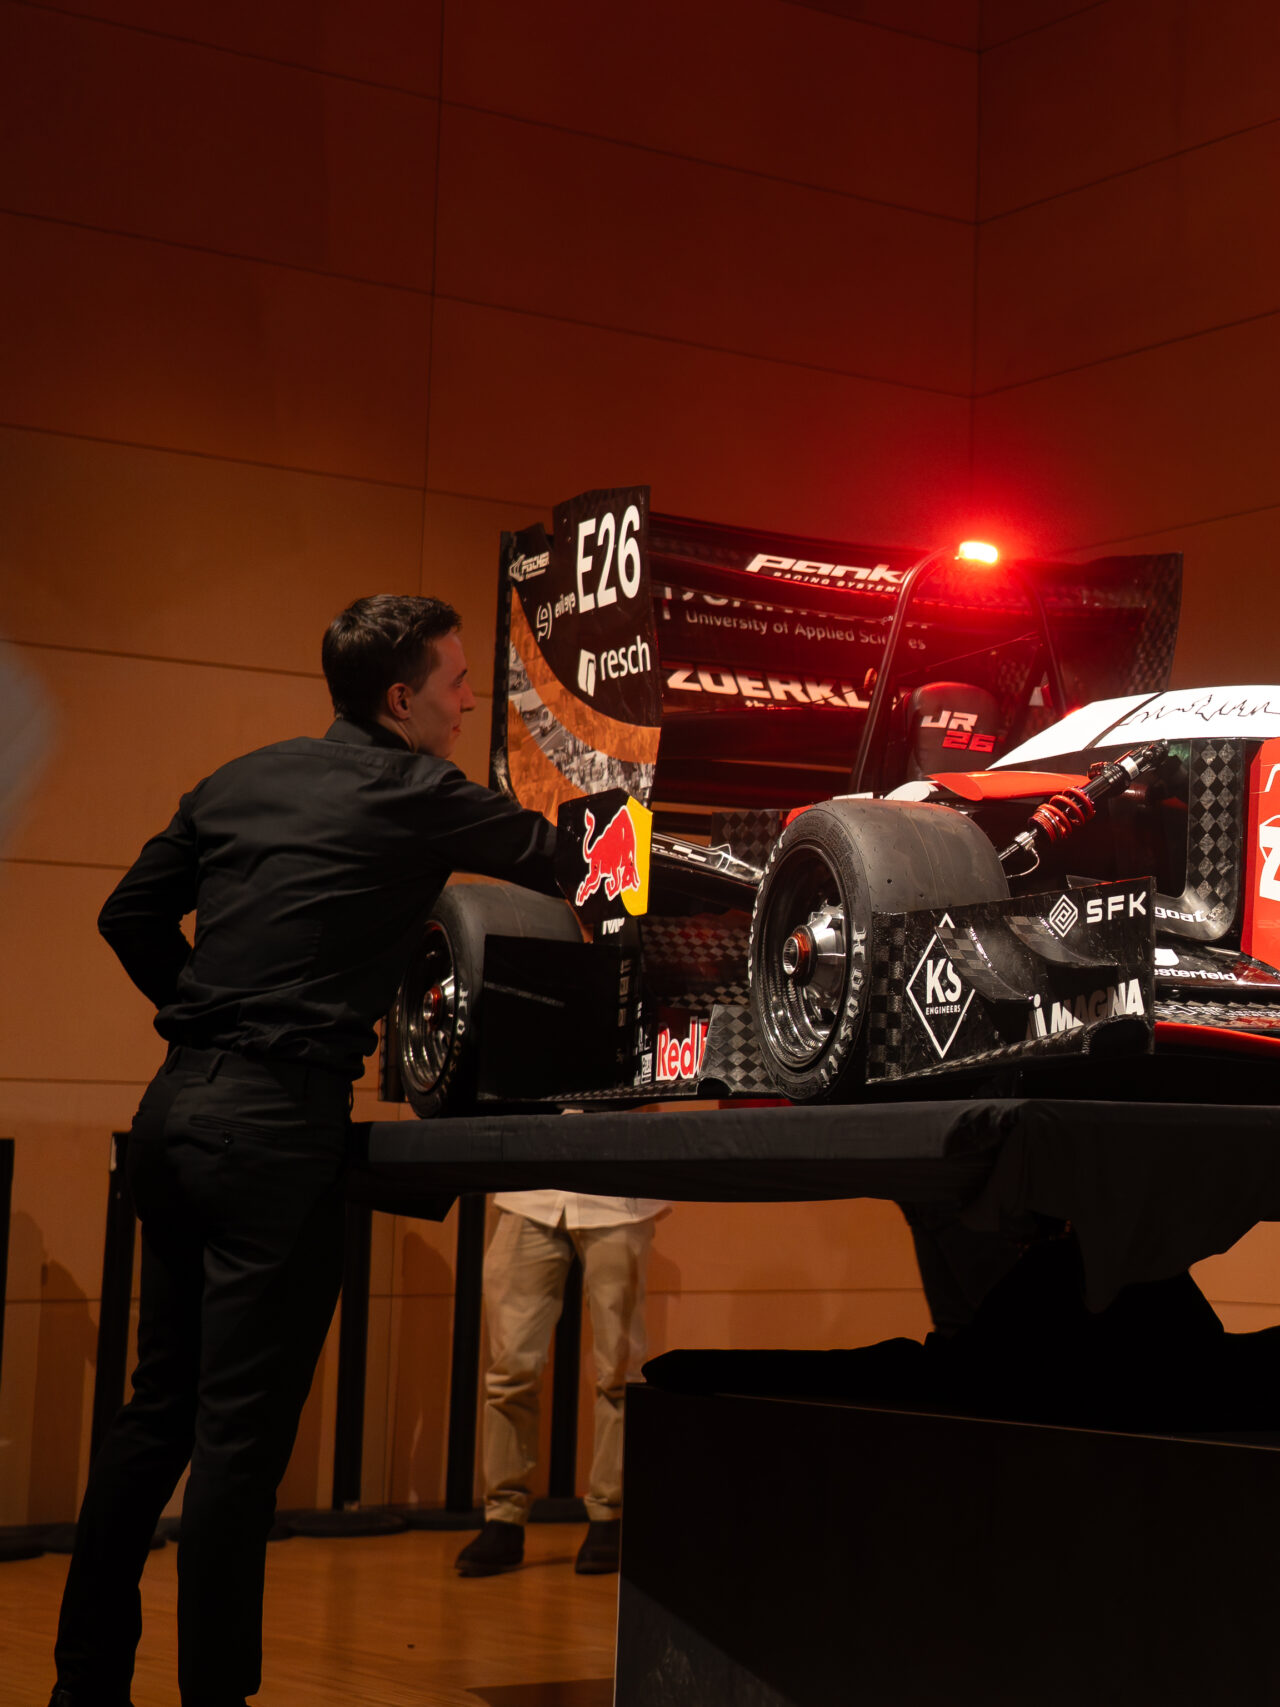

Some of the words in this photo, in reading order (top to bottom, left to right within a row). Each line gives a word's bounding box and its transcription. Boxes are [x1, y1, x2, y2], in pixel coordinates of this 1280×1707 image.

[576, 504, 641, 613] E26
[745, 553, 905, 584] Pank
[773, 571, 830, 585] RACING
[835, 579, 900, 593] SYSTEM
[686, 609, 768, 636] University
[773, 621, 789, 634] of
[795, 623, 855, 642] Applied
[859, 630, 926, 651] Scies
[600, 635, 651, 681] resch
[666, 669, 872, 709] ZOERKL
[920, 710, 978, 731] JR
[942, 730, 996, 752] 26
[1086, 891, 1147, 923] SFK
[1155, 906, 1208, 923] goat
[926, 958, 962, 1004] KS
[926, 1004, 961, 1016] ENGINEERS
[1051, 978, 1145, 1033] MAGNA
[655, 1016, 698, 1081] Red
